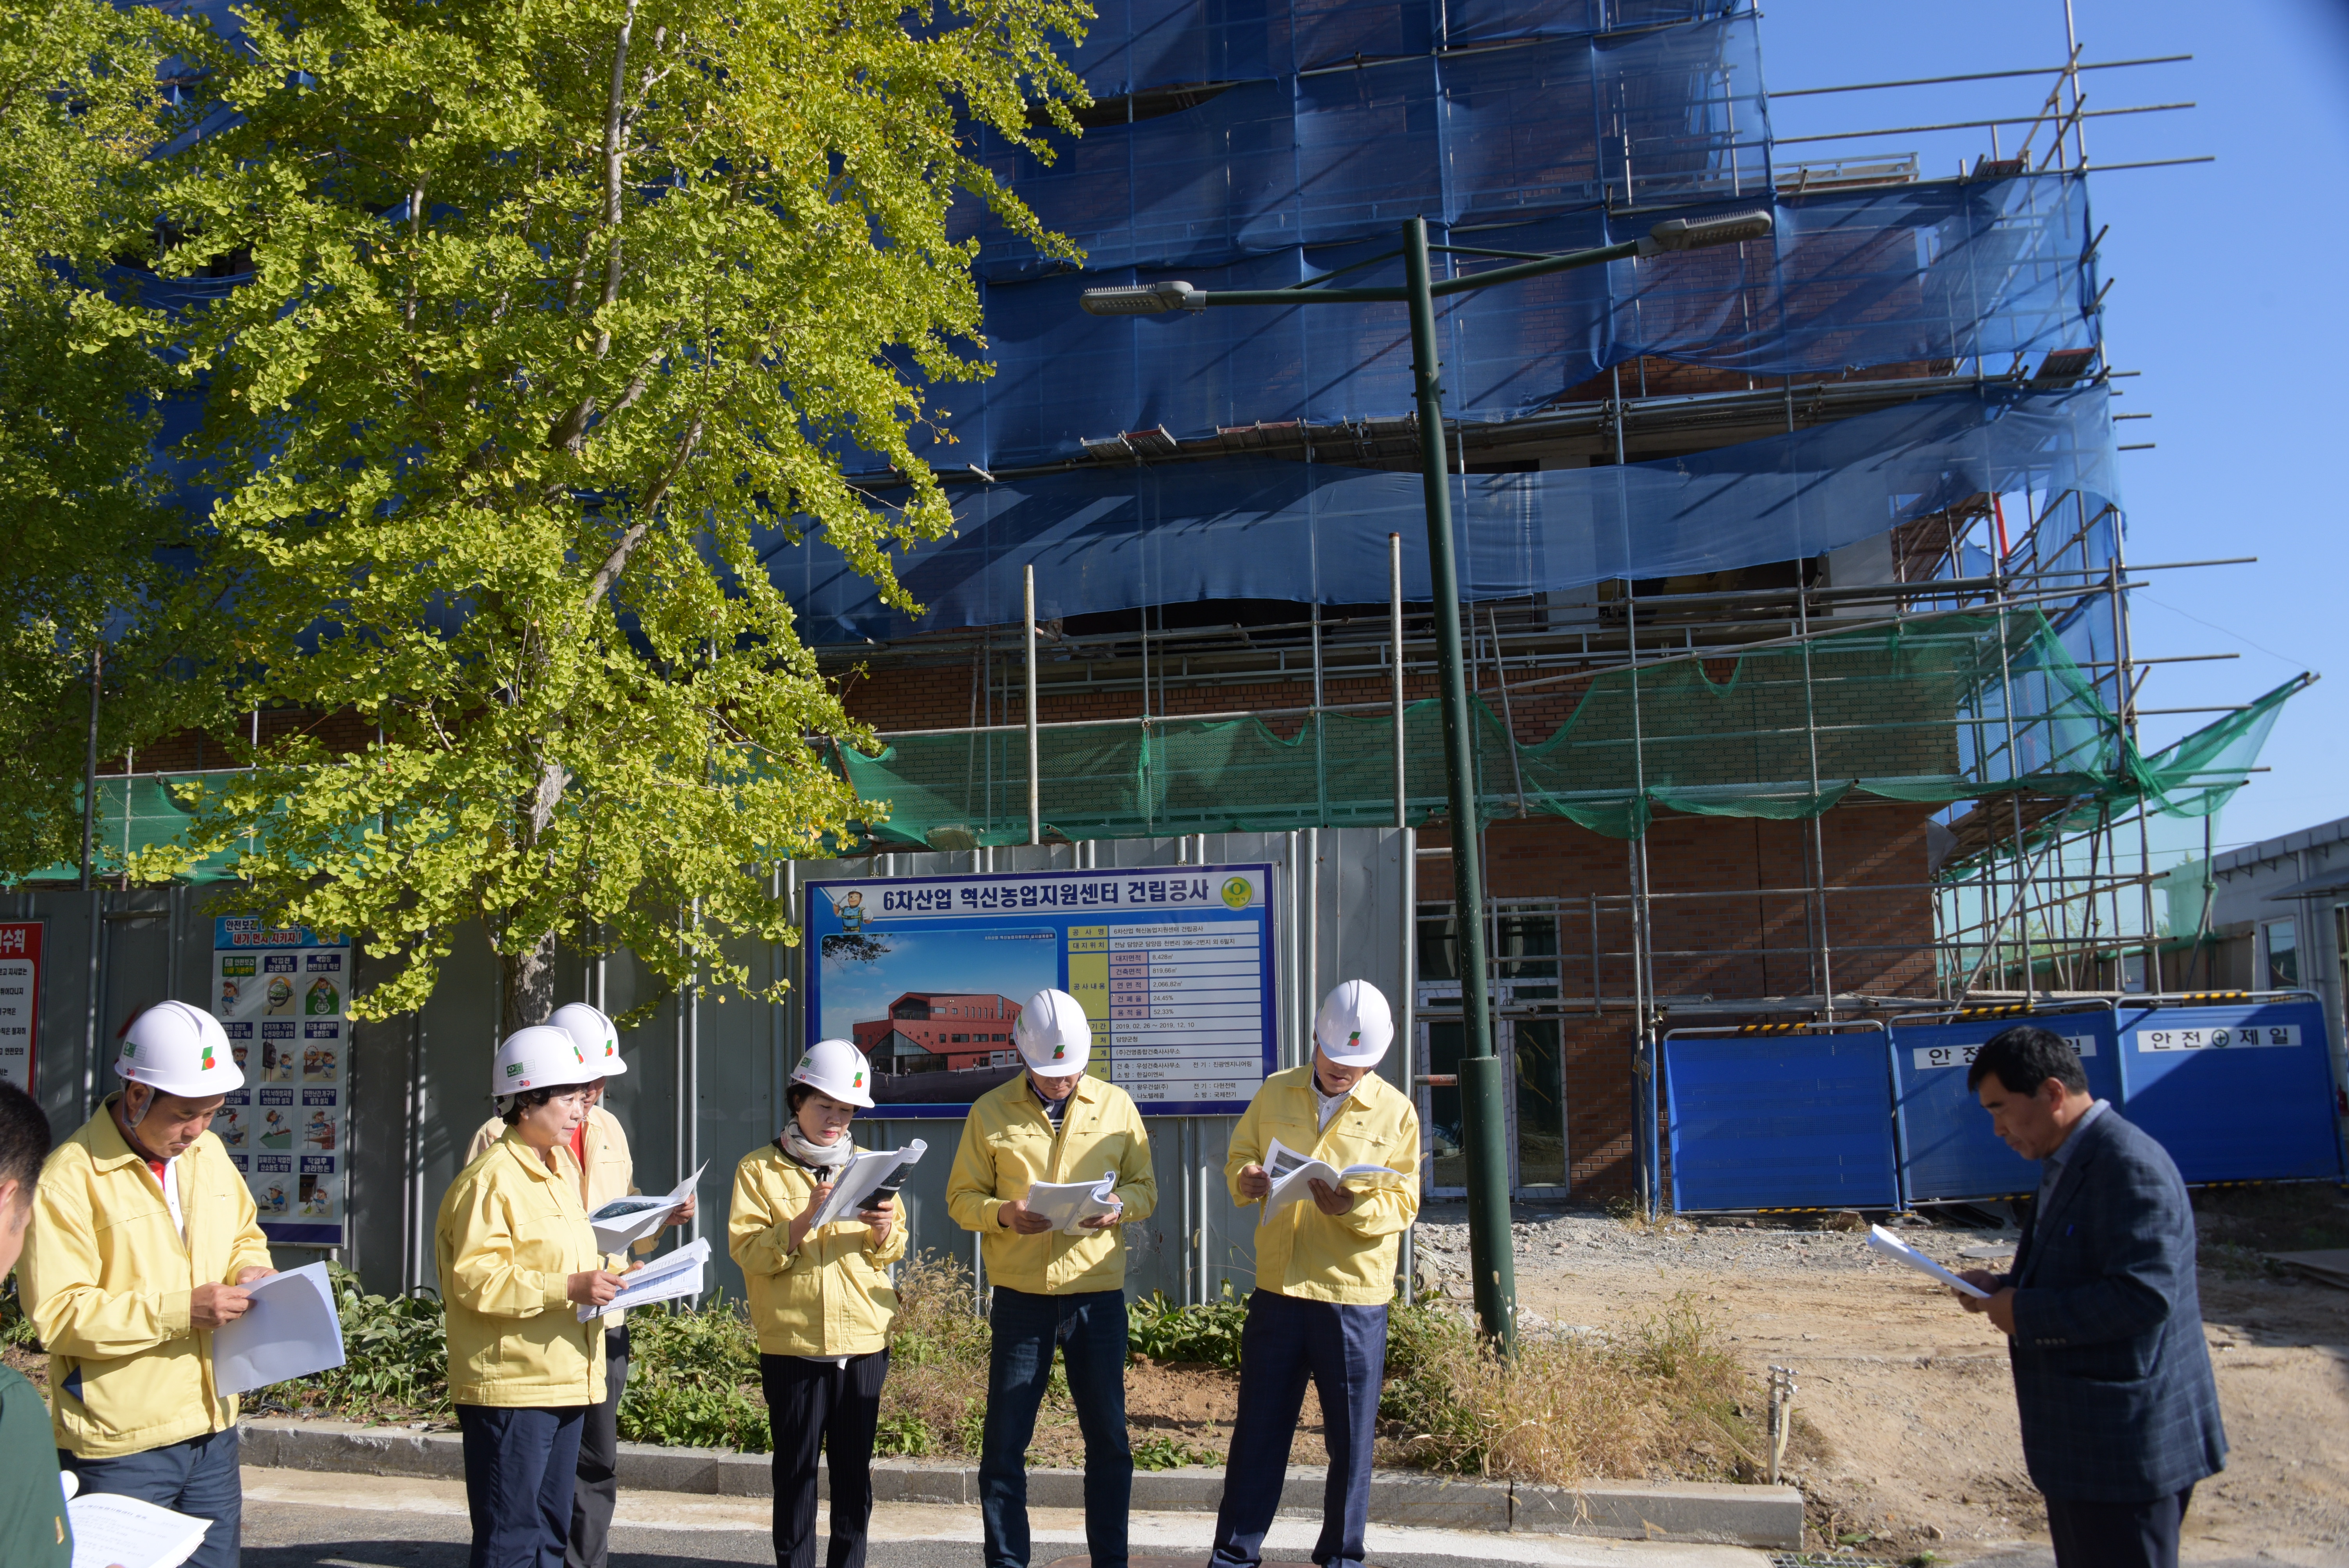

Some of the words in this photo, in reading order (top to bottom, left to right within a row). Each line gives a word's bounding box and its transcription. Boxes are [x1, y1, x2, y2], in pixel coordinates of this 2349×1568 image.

[883, 888, 951, 911] 6차산업
[960, 882, 1118, 909] 혁신농업지원센터
[1128, 879, 1209, 904] 건립공사
[0, 929, 25, 953] 수칙
[234, 934, 250, 944] 내가
[271, 932, 296, 943] 지키자
